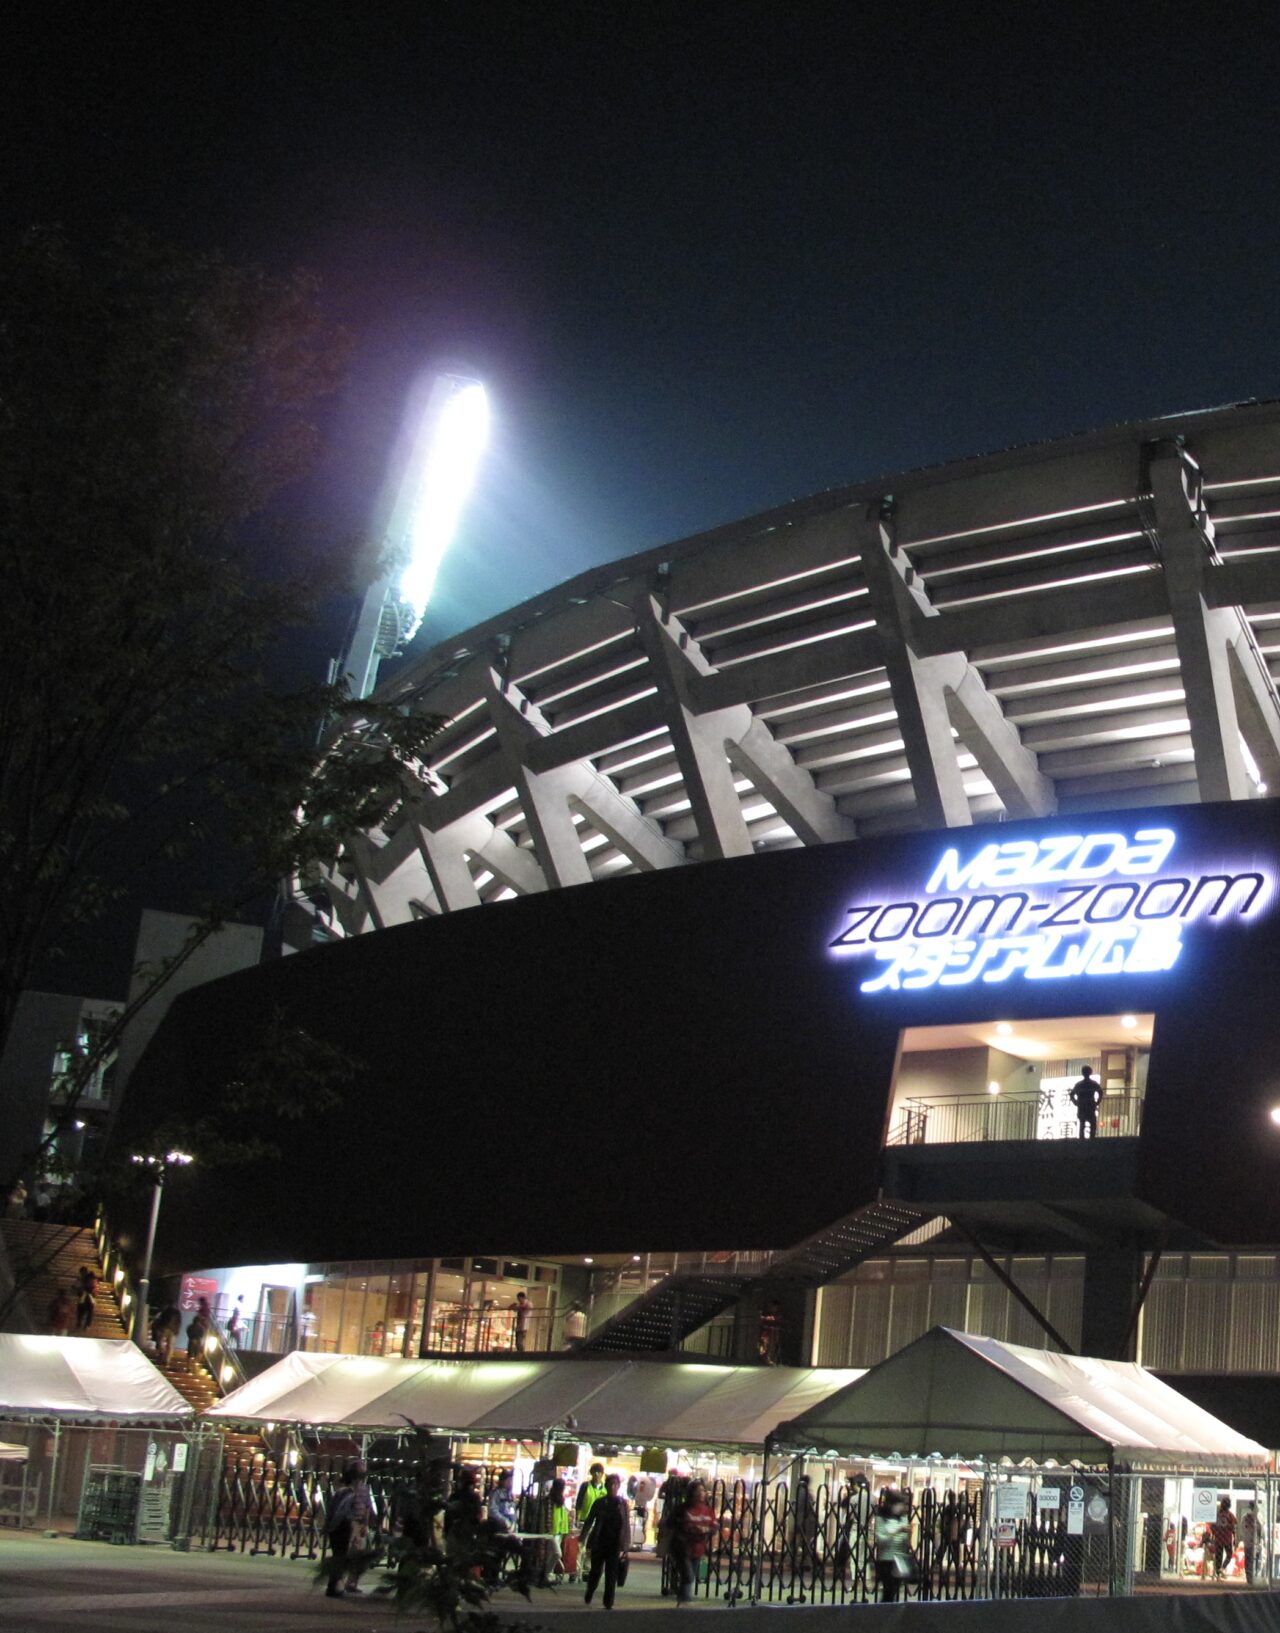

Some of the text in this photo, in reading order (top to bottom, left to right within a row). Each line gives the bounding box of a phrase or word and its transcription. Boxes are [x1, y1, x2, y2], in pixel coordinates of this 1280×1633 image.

[829, 872, 1265, 948] zoom-zoom
[859, 923, 1184, 993] スタジアム広島
